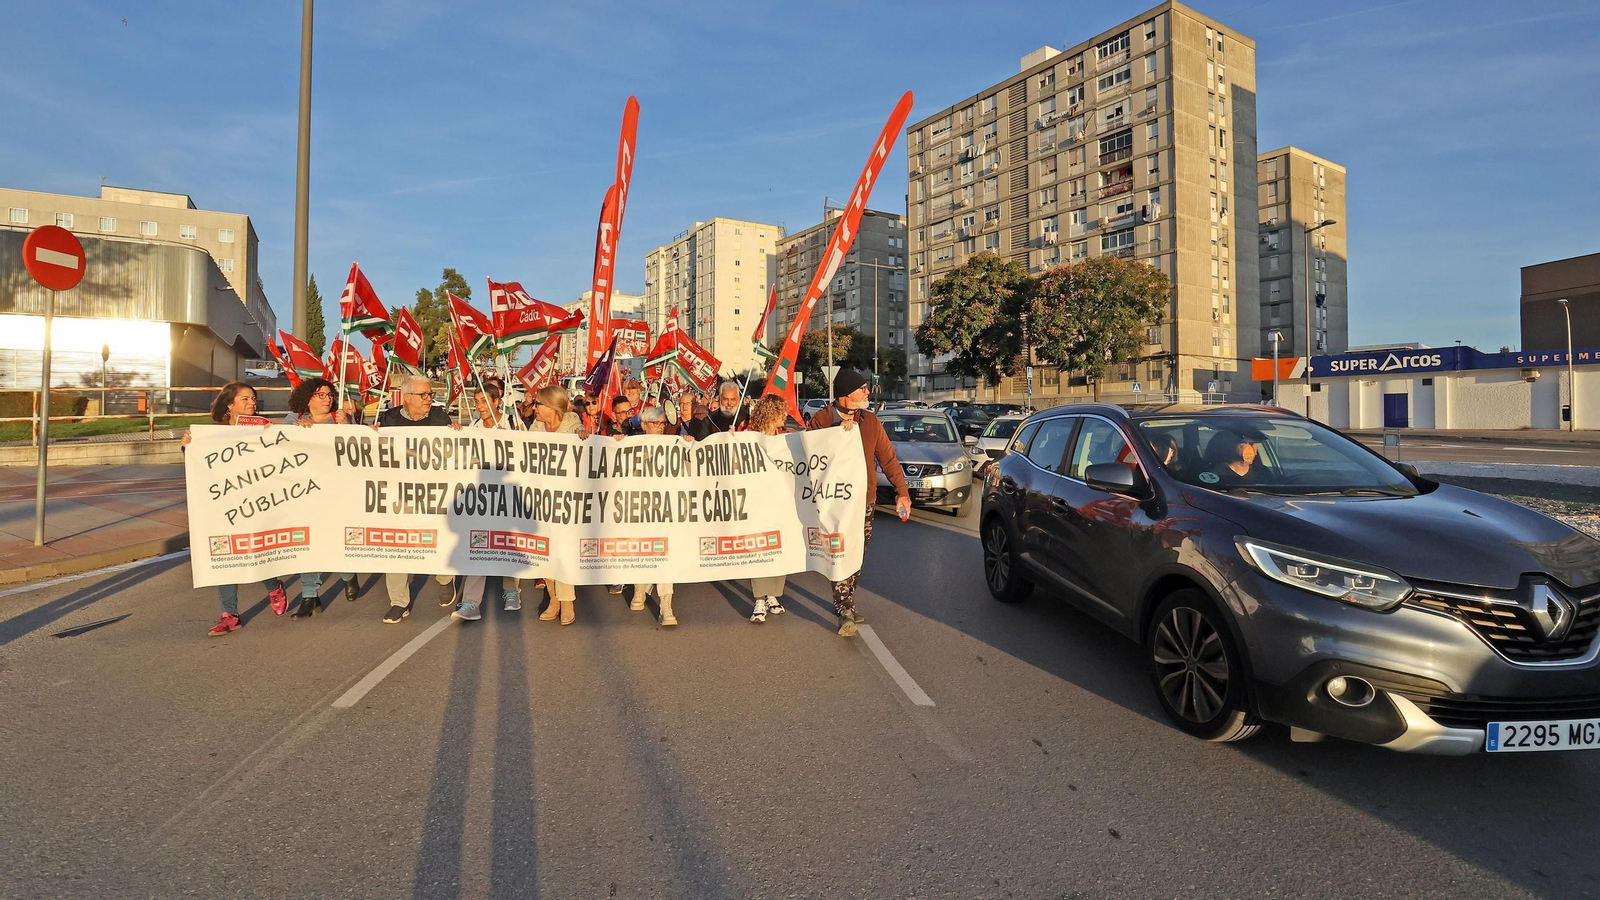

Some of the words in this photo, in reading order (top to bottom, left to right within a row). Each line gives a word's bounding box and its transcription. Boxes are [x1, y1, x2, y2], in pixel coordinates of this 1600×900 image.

[519, 309, 541, 323] Cádiz
[1330, 358, 1377, 372] SUPER
[204, 441, 255, 469] POR
[259, 430, 290, 448] LA
[334, 435, 374, 468] POR
[378, 436, 400, 469] EL
[405, 437, 491, 471] HOSPITAL
[494, 439, 515, 472] DE
[519, 441, 568, 477] JEREZ
[572, 445, 583, 478] Y
[588, 445, 608, 479] LA
[612, 438, 692, 478] ATENCIÓN
[695, 442, 767, 477] PRIMARIA
[209, 453, 309, 500] SANIDAD
[224, 479, 321, 526] PÚBLICA
[365, 480, 388, 514] DE
[392, 481, 449, 515] JEREZ
[453, 482, 508, 517] COSTA
[512, 485, 593, 525] NOROESTE
[598, 491, 609, 523] Y
[613, 490, 673, 524] SIERRA
[677, 490, 698, 523] DE
[702, 481, 748, 522] CÁDIZ
[235, 531, 291, 551] CCOO
[369, 531, 420, 544] CCOO
[493, 534, 536, 550] CCOO
[721, 535, 767, 552] CCOO
[603, 541, 652, 553] CCOO
[210, 555, 243, 563] federación
[254, 549, 276, 559] sanidad
[530, 554, 549, 562] sectores
[211, 561, 258, 570] sociosanitarios
[1503, 724, 1560, 747] 2295
[1568, 722, 1600, 746] MG
[1490, 739, 1495, 747] E
